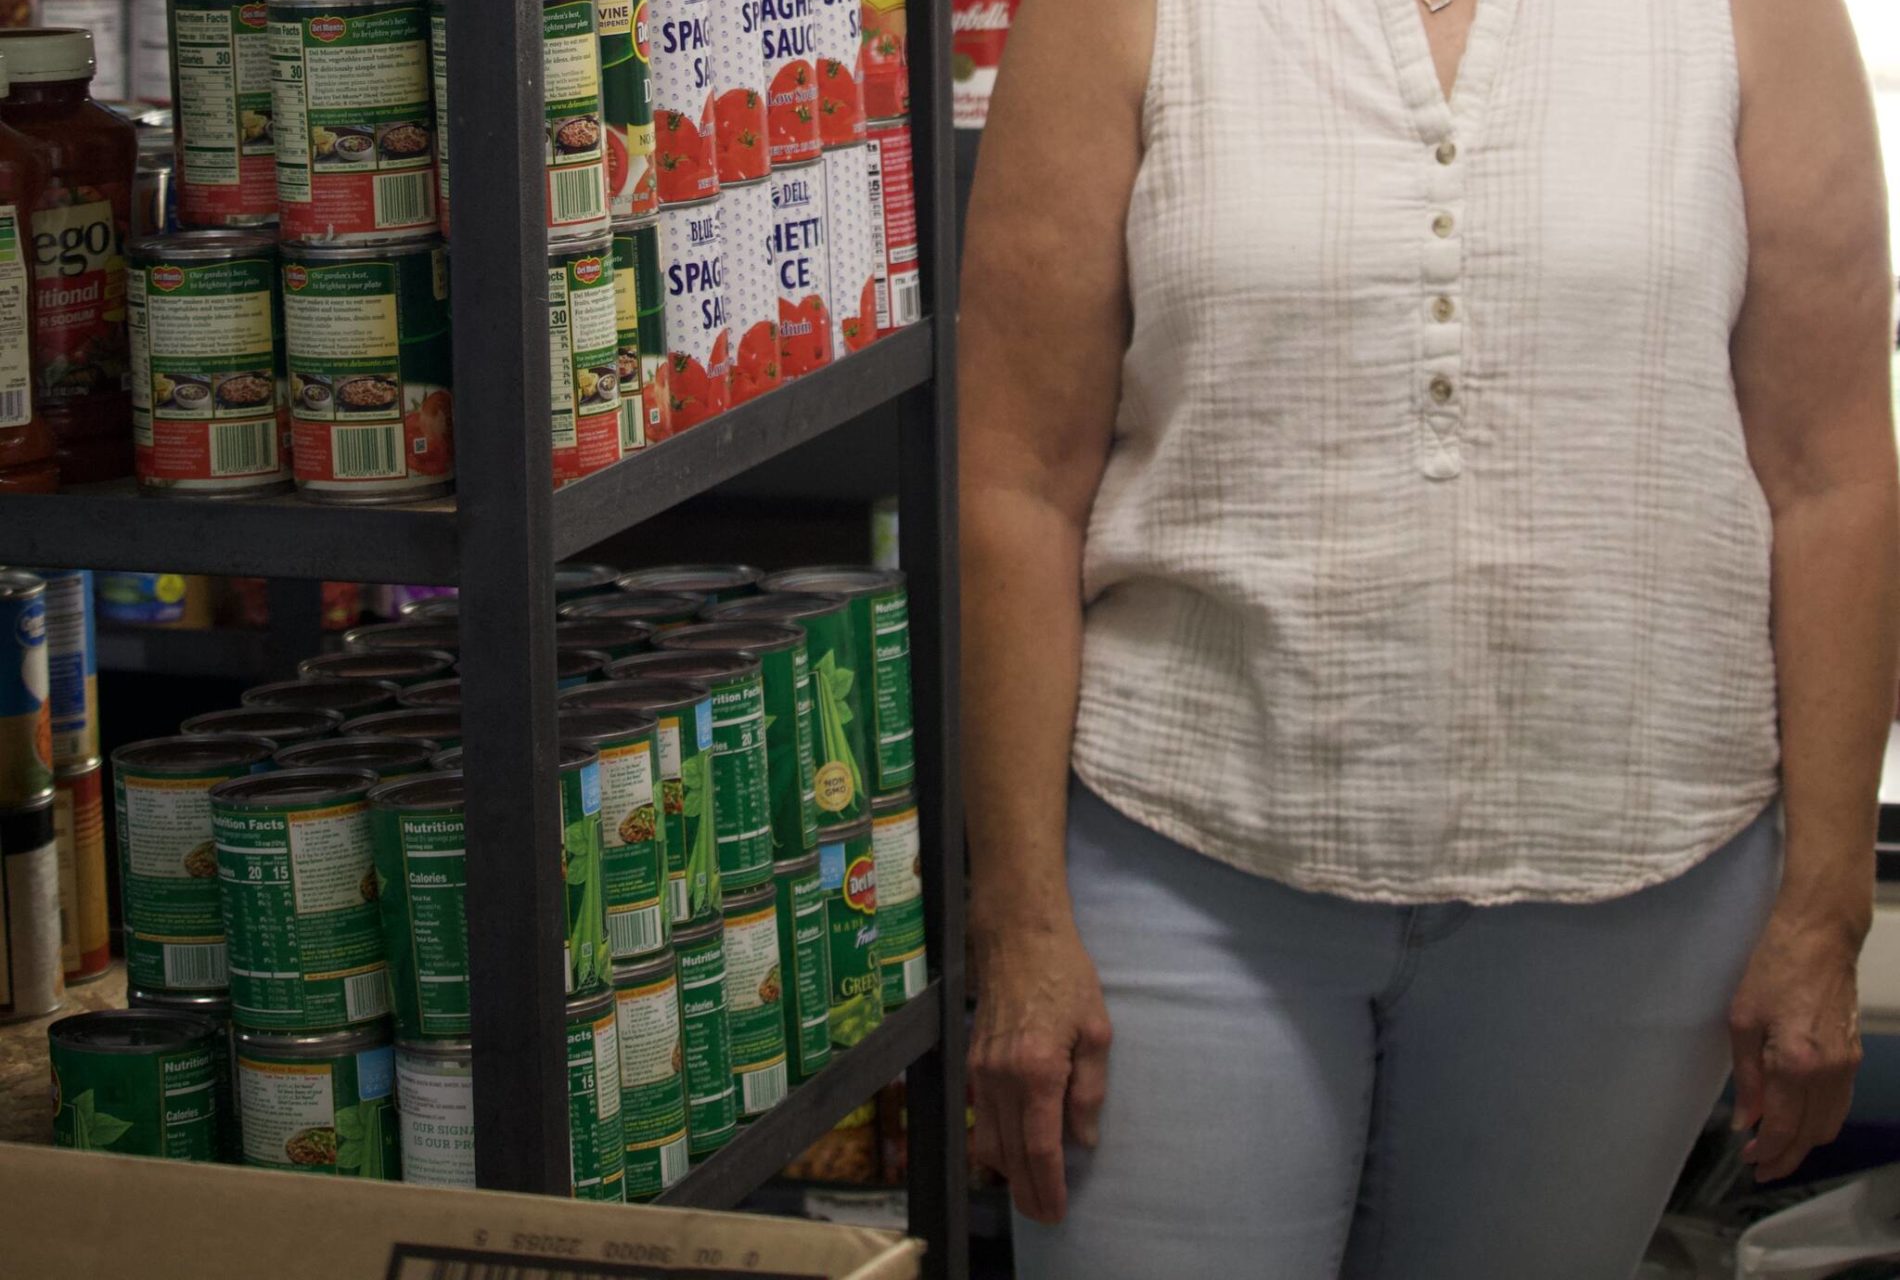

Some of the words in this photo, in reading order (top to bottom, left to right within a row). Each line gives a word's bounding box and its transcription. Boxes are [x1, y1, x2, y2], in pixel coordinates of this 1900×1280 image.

[206, 13, 228, 23] Facts
[600, 6, 628, 19] VINE
[282, 25, 300, 36] Facts
[312, 24, 322, 32] Del
[323, 24, 343, 32] Monte
[352, 21, 366, 29] Our
[367, 19, 393, 29] garden's
[565, 22, 578, 31] your
[600, 19, 629, 29] RIPENED
[361, 29, 388, 39] brighten
[390, 28, 403, 37] your
[216, 51, 230, 65] 30
[290, 65, 302, 78] 30
[768, 92, 793, 107] Low
[784, 182, 811, 203] DELL
[690, 217, 714, 246] BLUE
[189, 271, 202, 279] Our
[204, 271, 232, 280] garden's
[324, 272, 350, 280] garden's
[780, 258, 811, 290] CE
[199, 281, 228, 290] brighten
[319, 282, 346, 291] brighten
[364, 281, 382, 289] plate
[552, 310, 567, 325] 30
[741, 732, 753, 746] 20
[823, 775, 846, 789] NON
[824, 785, 847, 798] GMO
[249, 819, 285, 830] Facts
[404, 821, 464, 834] Nutrition
[248, 867, 263, 880] 20
[273, 867, 289, 879] 15
[409, 872, 447, 885] Calories
[851, 876, 866, 895] Del
[682, 950, 722, 968] Nutrition
[685, 998, 714, 1014] Calories
[164, 1055, 209, 1074] Nutrition
[582, 1075, 594, 1089] 15
[166, 1106, 200, 1121] Calories
[413, 1121, 434, 1135] OUR
[414, 1135, 423, 1146] IS
[425, 1137, 450, 1150] OUR
